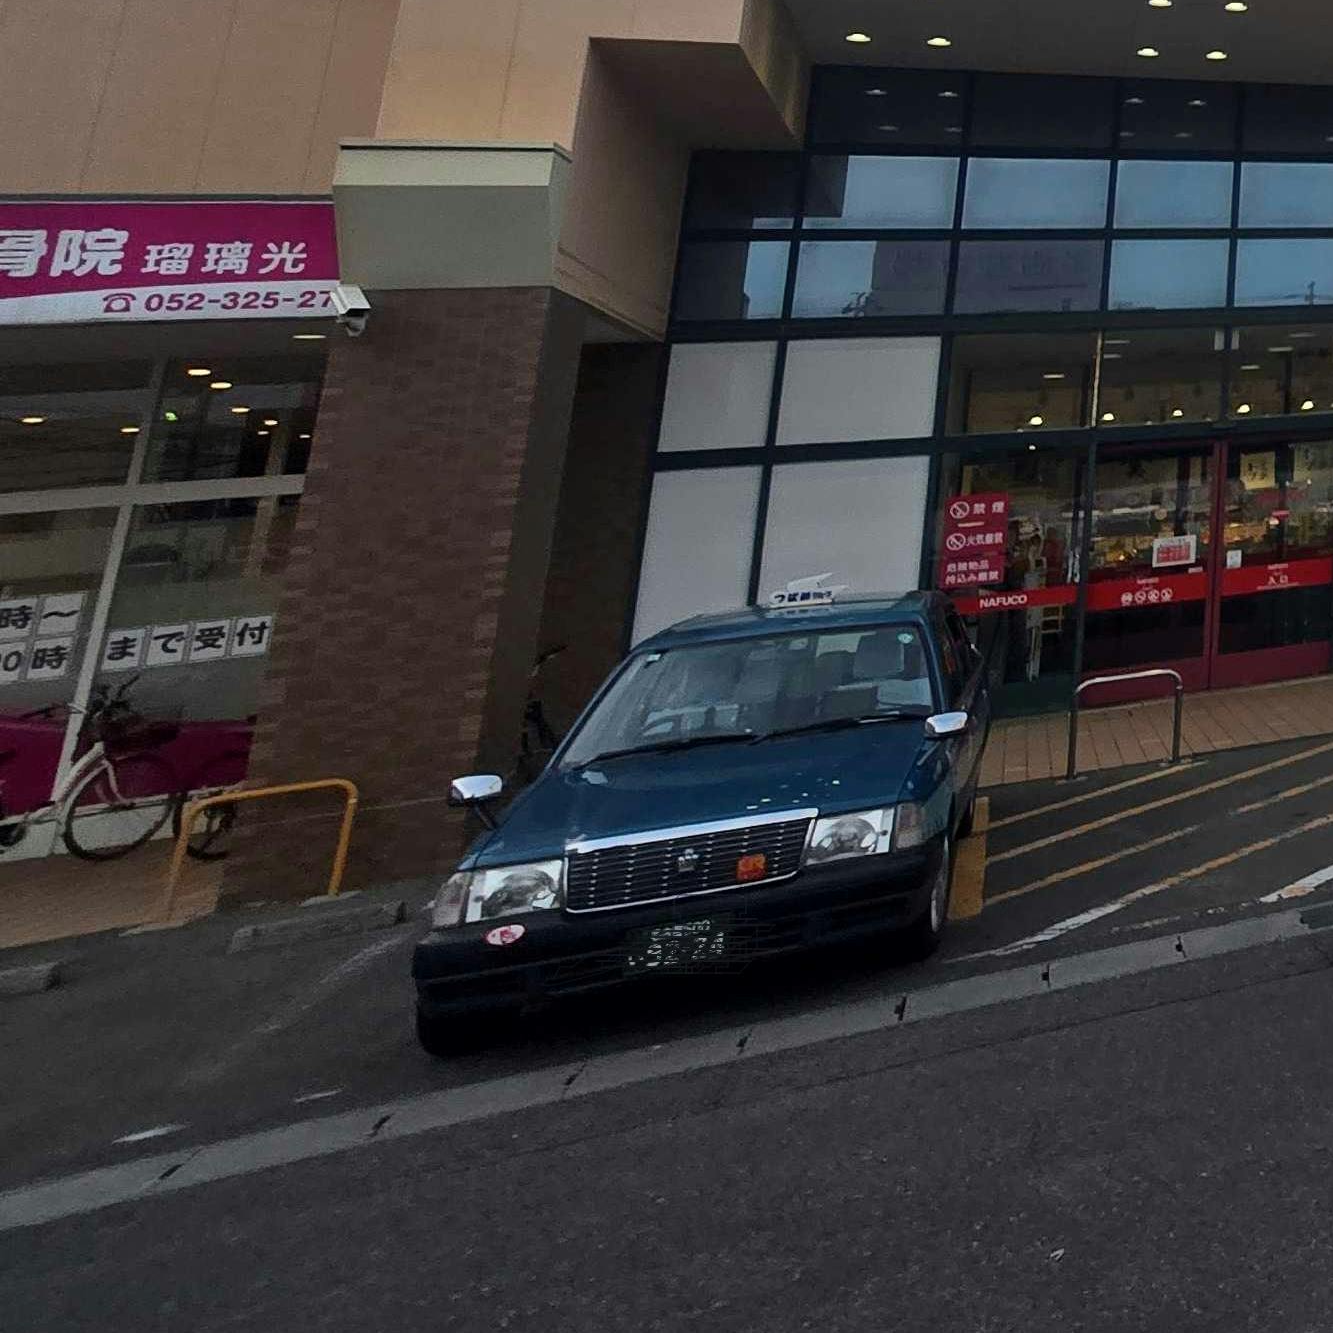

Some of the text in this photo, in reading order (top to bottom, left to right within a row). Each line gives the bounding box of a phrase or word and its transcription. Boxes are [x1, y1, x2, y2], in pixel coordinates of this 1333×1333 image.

[141, 241, 307, 275] 瑠璃光
[979, 594, 1028, 608] NAFUCO
[106, 621, 270, 661] まで受付
